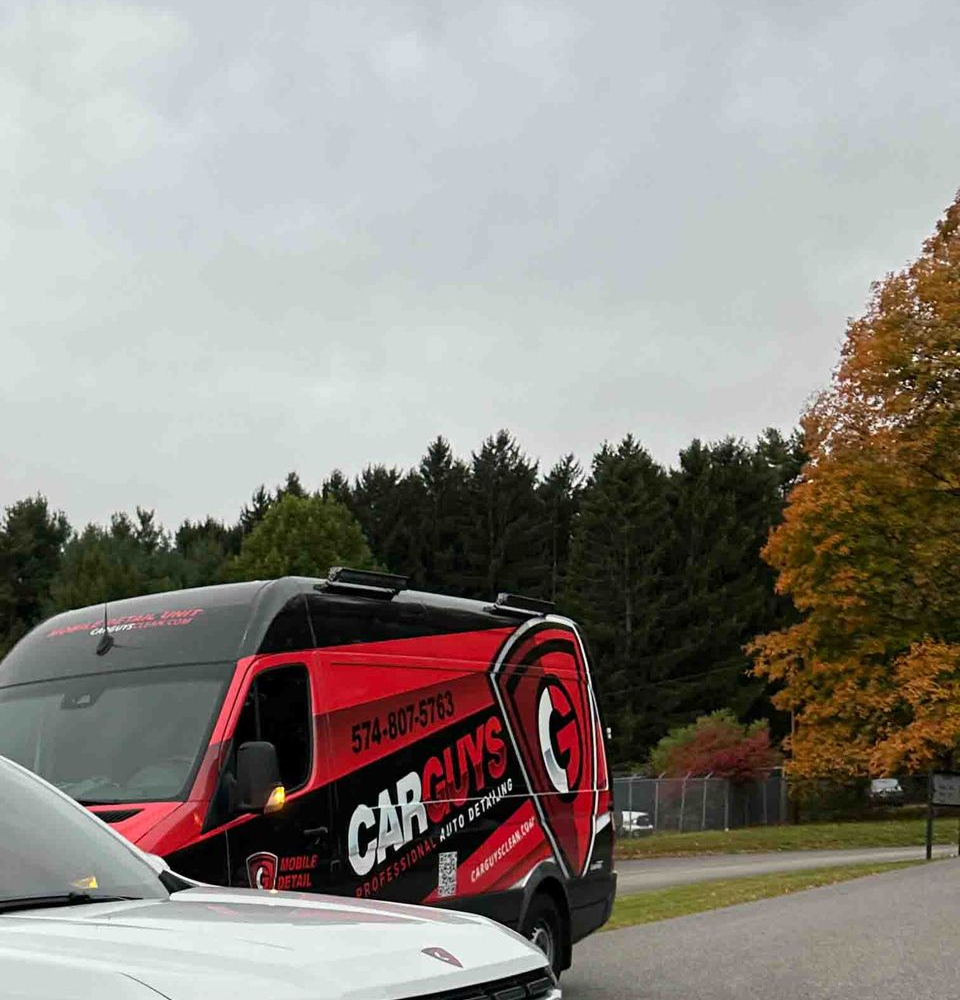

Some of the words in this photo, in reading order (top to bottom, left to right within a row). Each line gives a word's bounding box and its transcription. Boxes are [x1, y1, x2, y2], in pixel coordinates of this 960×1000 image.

[161, 609, 204, 619] UNIT
[352, 690, 454, 753] 574-807-5763
[355, 836, 437, 899] PROFESSIONAL
[439, 817, 465, 843] AUTO
[468, 778, 513, 822] DETAILING
[470, 815, 536, 883] CARGUYSCLEAN.COM
[278, 873, 312, 890] DETAIL
[280, 853, 319, 871] MOBILE
